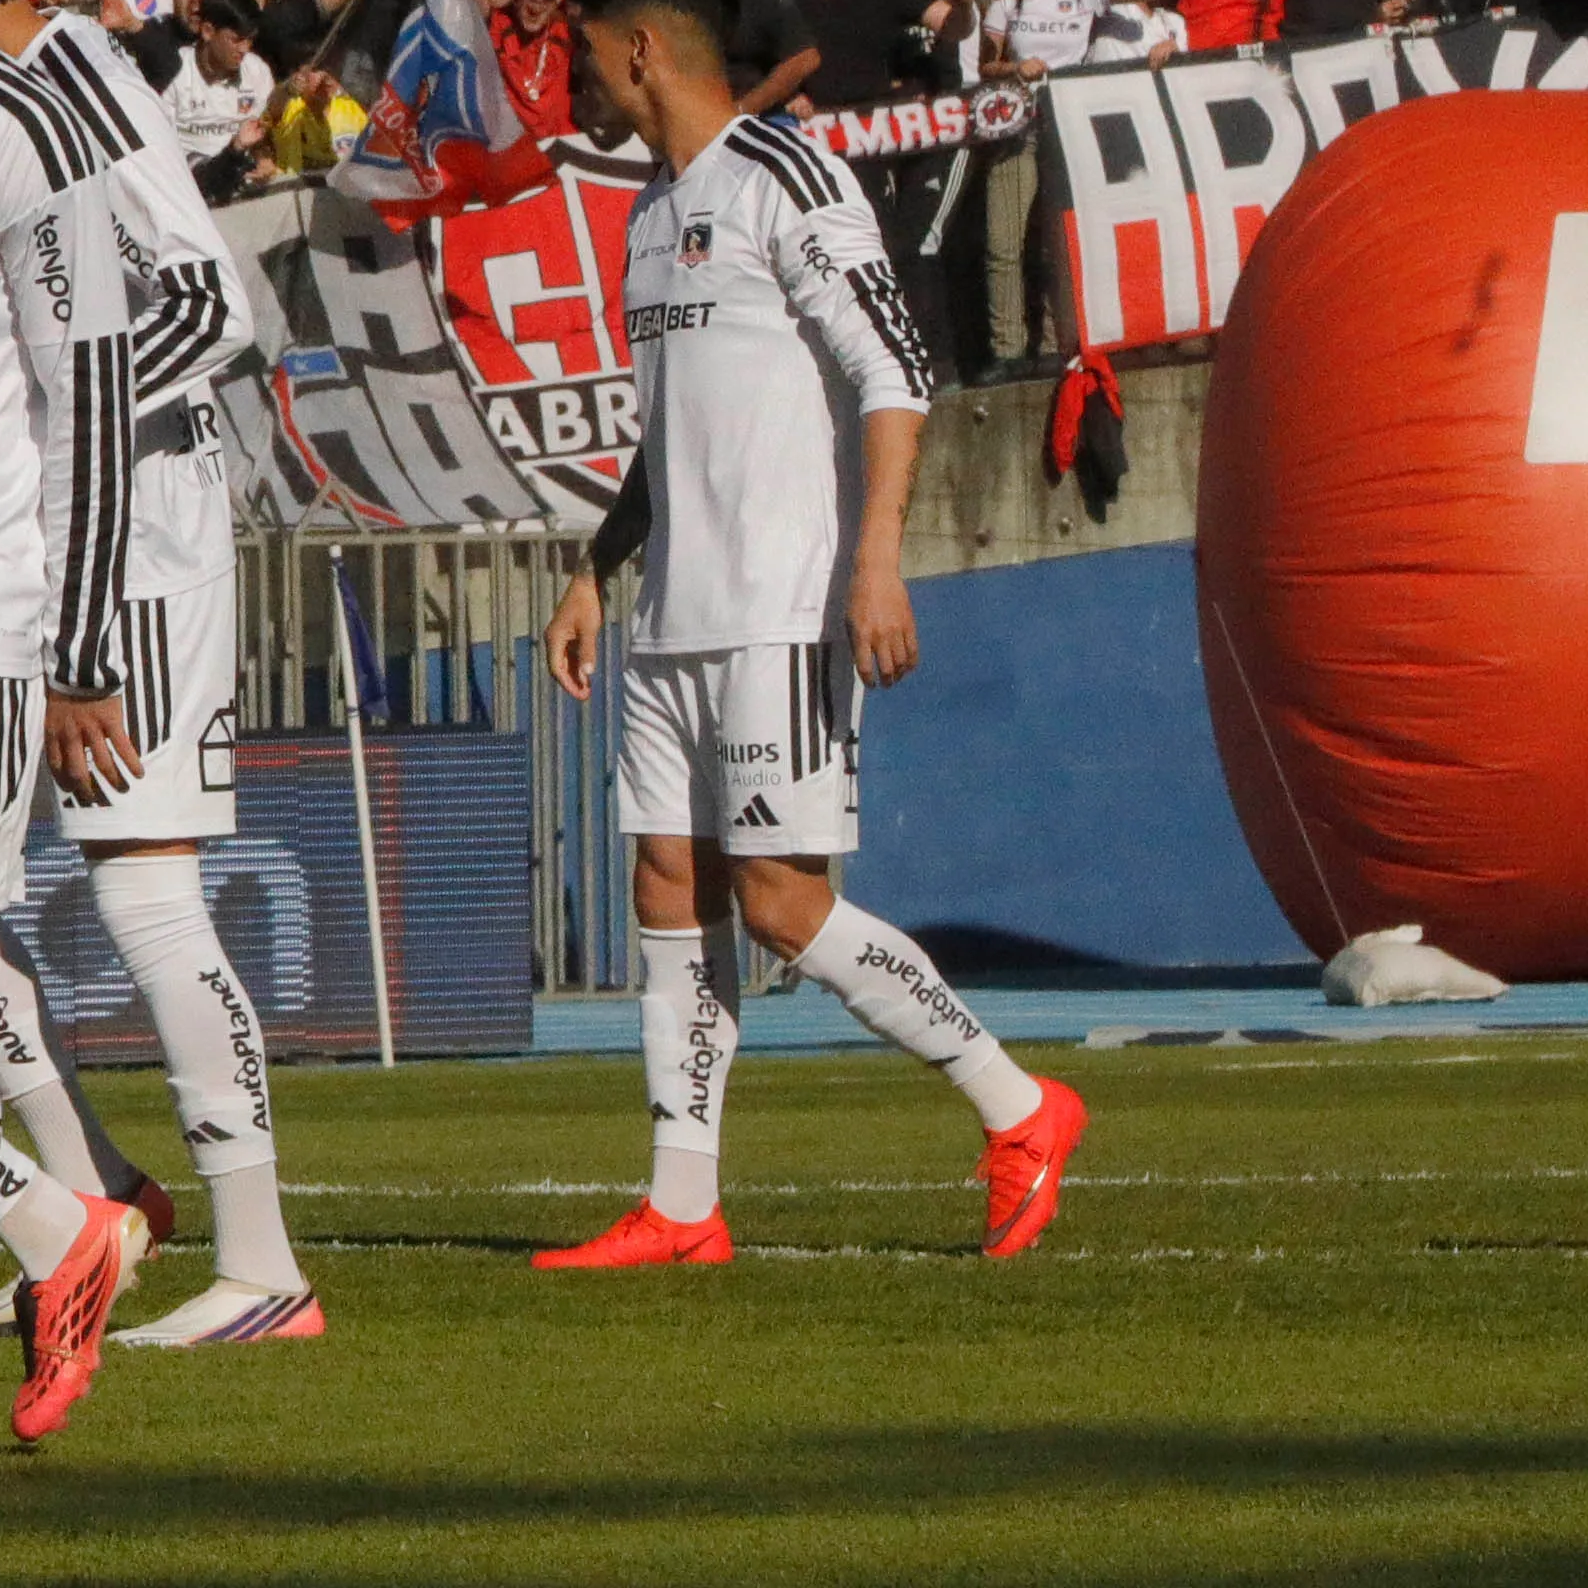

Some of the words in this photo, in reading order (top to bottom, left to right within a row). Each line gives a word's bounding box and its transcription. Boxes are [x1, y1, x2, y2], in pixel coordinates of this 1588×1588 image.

[482, 370, 642, 464] ABR
[198, 968, 270, 1131] AutoPlanet
[679, 958, 722, 1144] AutoPlanet
[855, 939, 983, 1045] AutoPlanet
